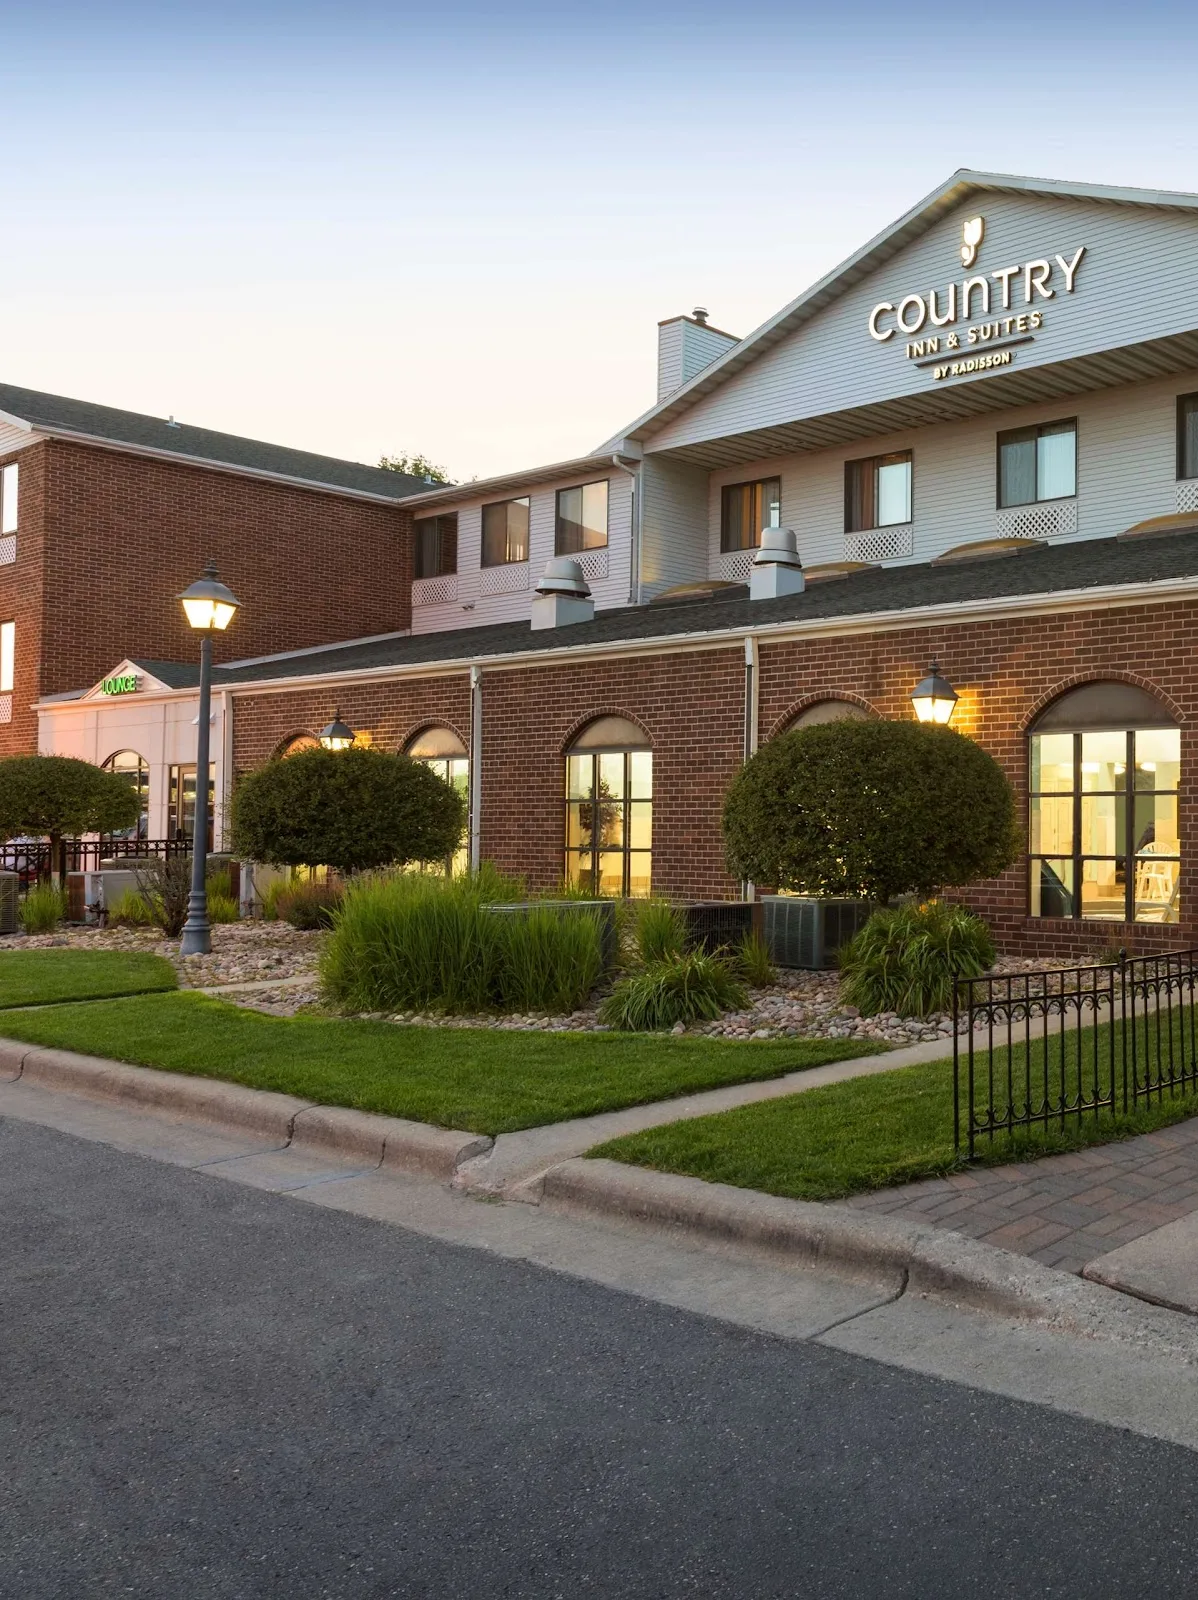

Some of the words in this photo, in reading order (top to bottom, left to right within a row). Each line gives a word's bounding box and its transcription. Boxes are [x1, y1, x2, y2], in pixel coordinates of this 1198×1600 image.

[868, 246, 1087, 341] COUNTRY
[906, 337, 940, 358] INN
[946, 331, 960, 349] &
[967, 311, 1042, 343] SUITES
[933, 367, 949, 380] BY
[951, 352, 1012, 376] RADISSON
[102, 675, 136, 695] LOUNGE
